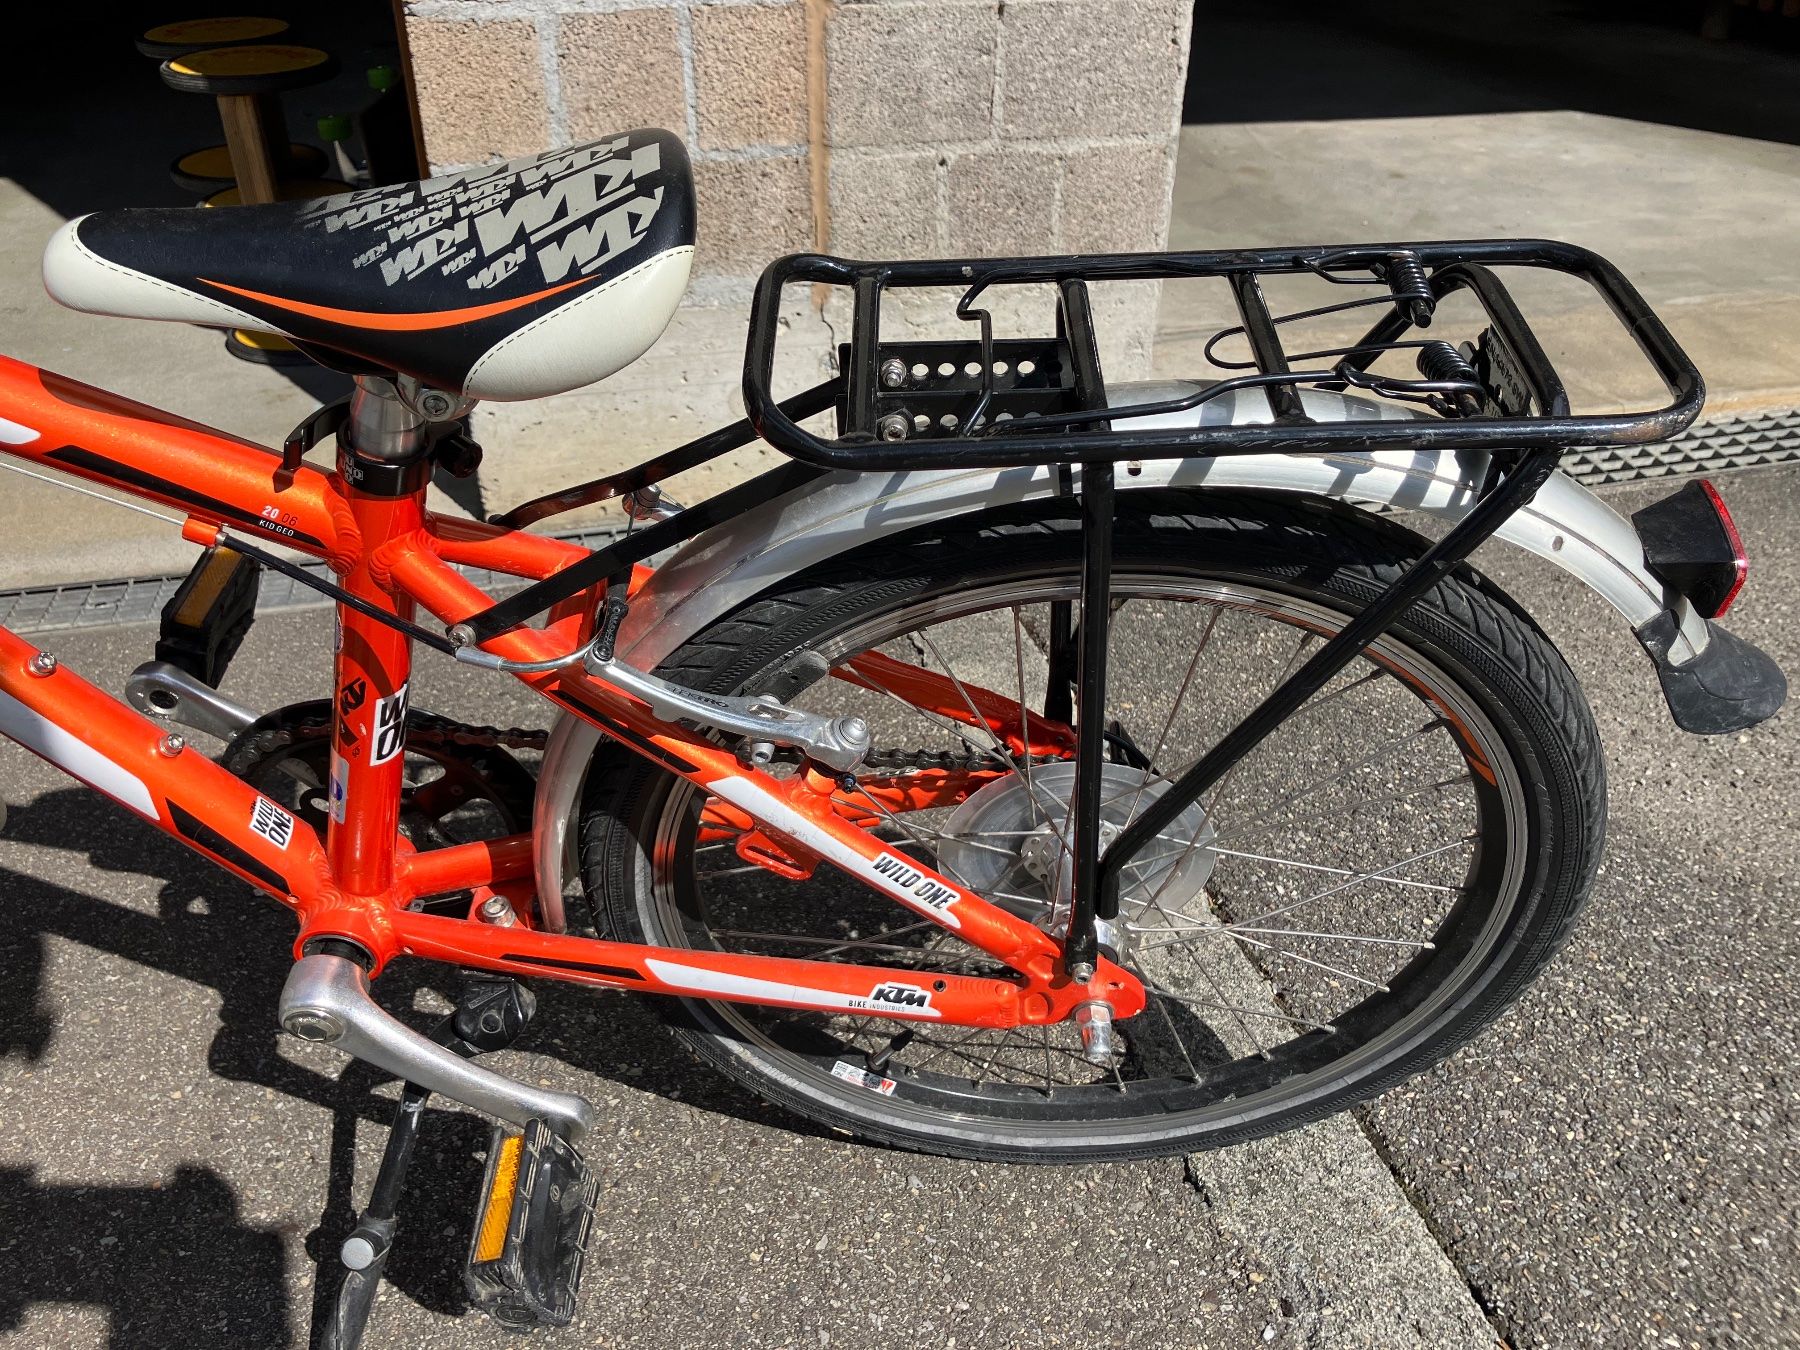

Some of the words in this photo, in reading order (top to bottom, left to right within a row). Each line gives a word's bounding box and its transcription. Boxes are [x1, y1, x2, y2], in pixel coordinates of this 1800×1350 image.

[520, 136, 630, 187] KTM
[426, 186, 463, 203] KTM
[455, 173, 517, 204] KTM
[458, 188, 511, 218] KTM
[473, 142, 661, 258] KTM
[325, 190, 416, 234] KTM
[388, 204, 453, 244] KTM
[393, 206, 425, 222] KTM
[537, 186, 665, 284] KTM
[352, 241, 388, 269] KTM
[380, 218, 469, 287] KTM
[441, 247, 477, 277] KTM
[466, 244, 527, 289] KTM
[259, 519, 275, 530] KID
[276, 525, 294, 537] GEO
[262, 505, 280, 519] 20
[281, 513, 298, 527] 06
[252, 798, 274, 835] WILD
[268, 807, 292, 847] ONE
[872, 855, 922, 888] WILD
[913, 880, 957, 910] ONE
[848, 1000, 867, 1009] BIKE
[873, 985, 928, 1008] KTM
